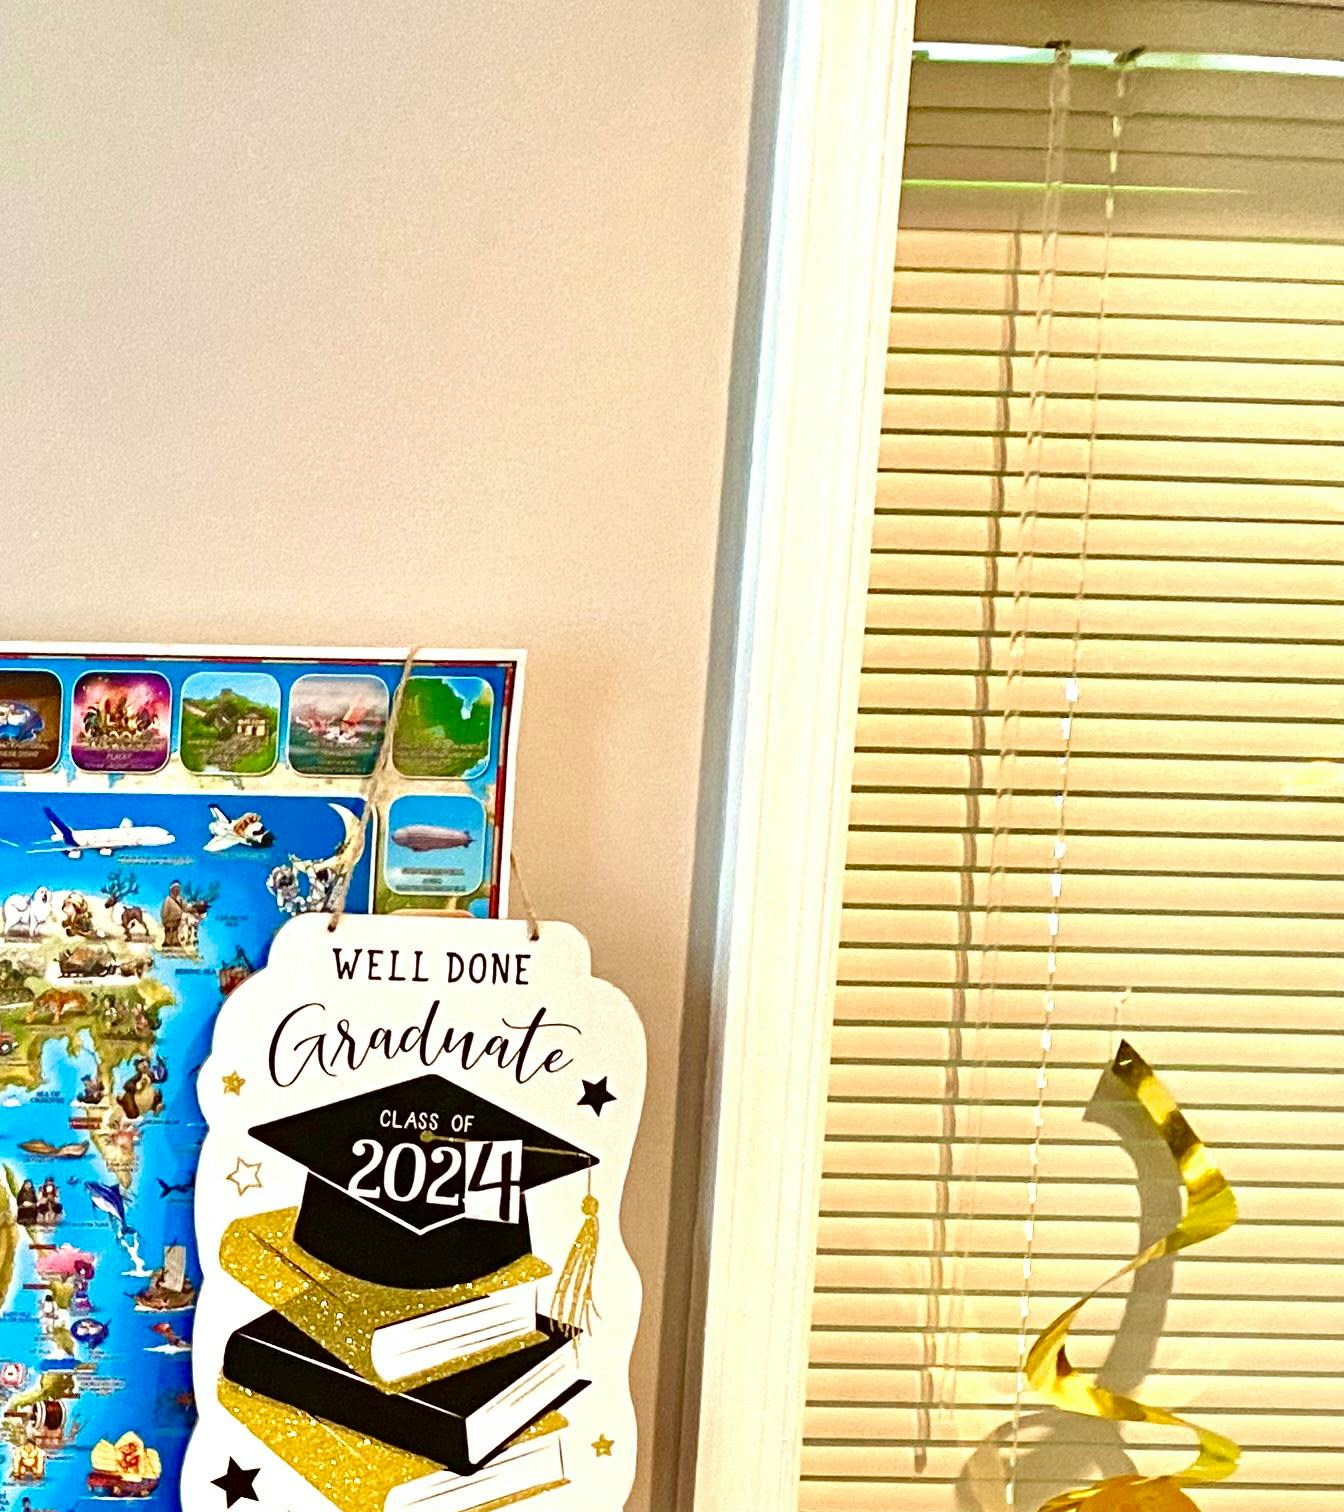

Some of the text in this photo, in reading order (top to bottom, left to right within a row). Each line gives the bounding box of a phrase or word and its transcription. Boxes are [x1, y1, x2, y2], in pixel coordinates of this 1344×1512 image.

[333, 948, 531, 985] WELL DONE
[268, 1000, 582, 1088] Graduate
[380, 1109, 475, 1133] CLASS OF
